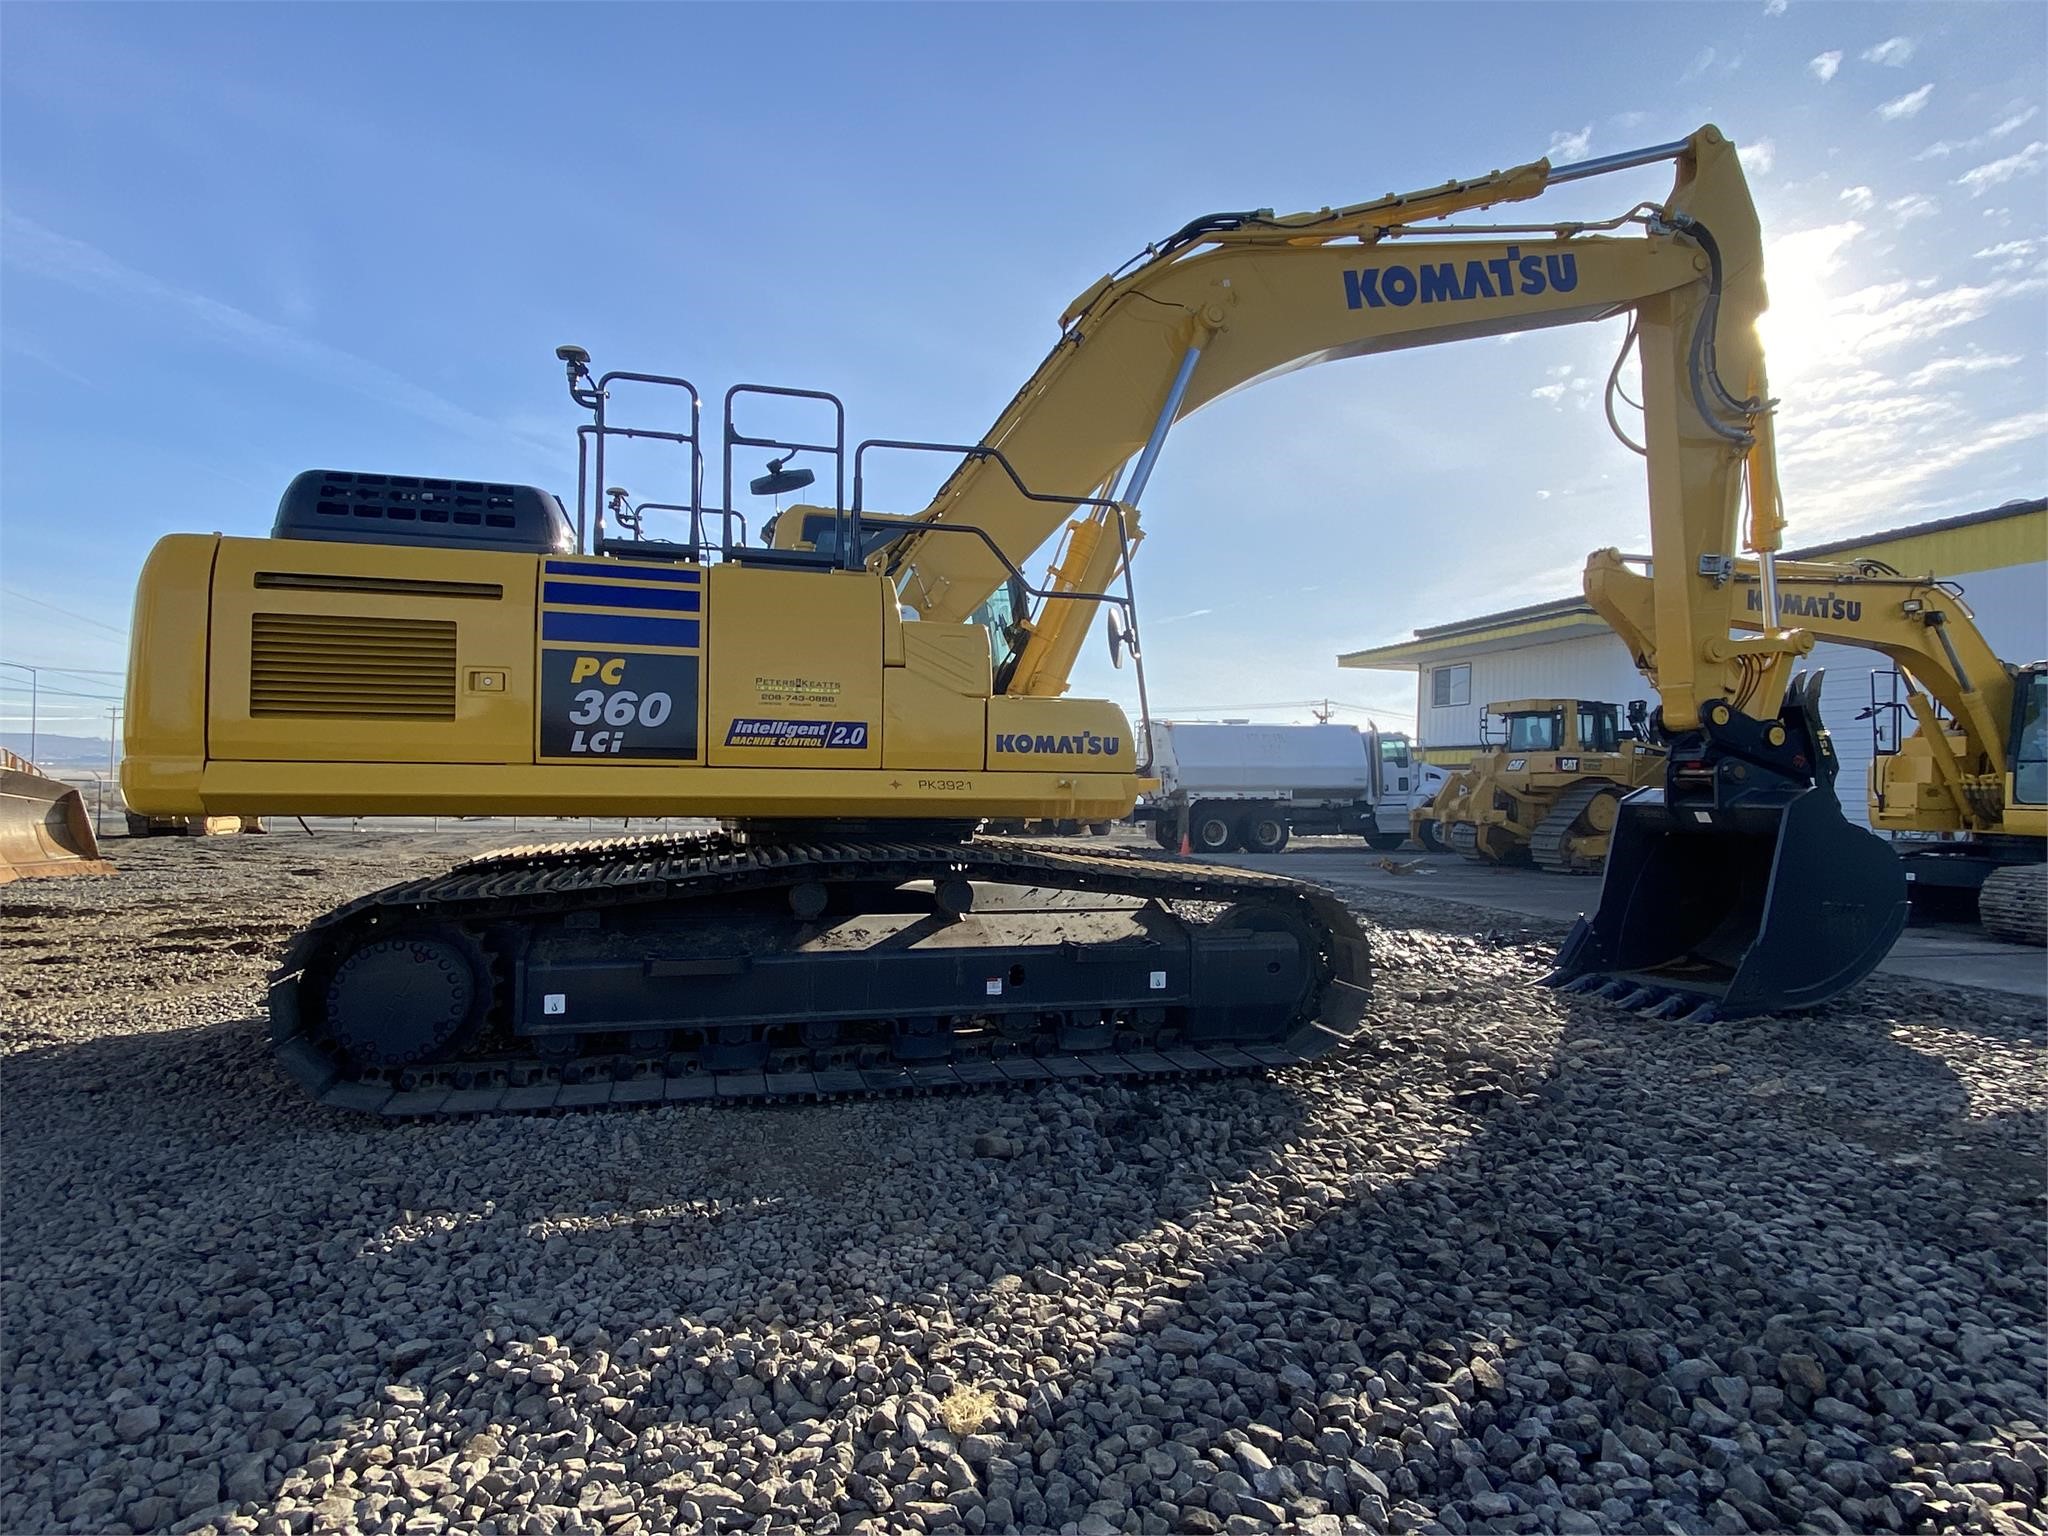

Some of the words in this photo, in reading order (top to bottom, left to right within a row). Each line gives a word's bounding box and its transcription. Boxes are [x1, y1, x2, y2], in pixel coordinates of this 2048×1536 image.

[1343, 245, 1578, 310] KOMATSU
[1747, 589, 1861, 622] KMATSU
[570, 656, 626, 685] PC
[569, 689, 672, 728] 360
[734, 720, 827, 738] intelligent
[831, 726, 865, 745] 2.0
[570, 730, 624, 753] LCi
[730, 736, 776, 746] MACHINE
[778, 737, 823, 747] CONTROL
[996, 731, 1120, 756] KOMATSU
[1507, 759, 1526, 771] CAT
[1561, 758, 1578, 771] CAT
[918, 780, 973, 791] PK3921
